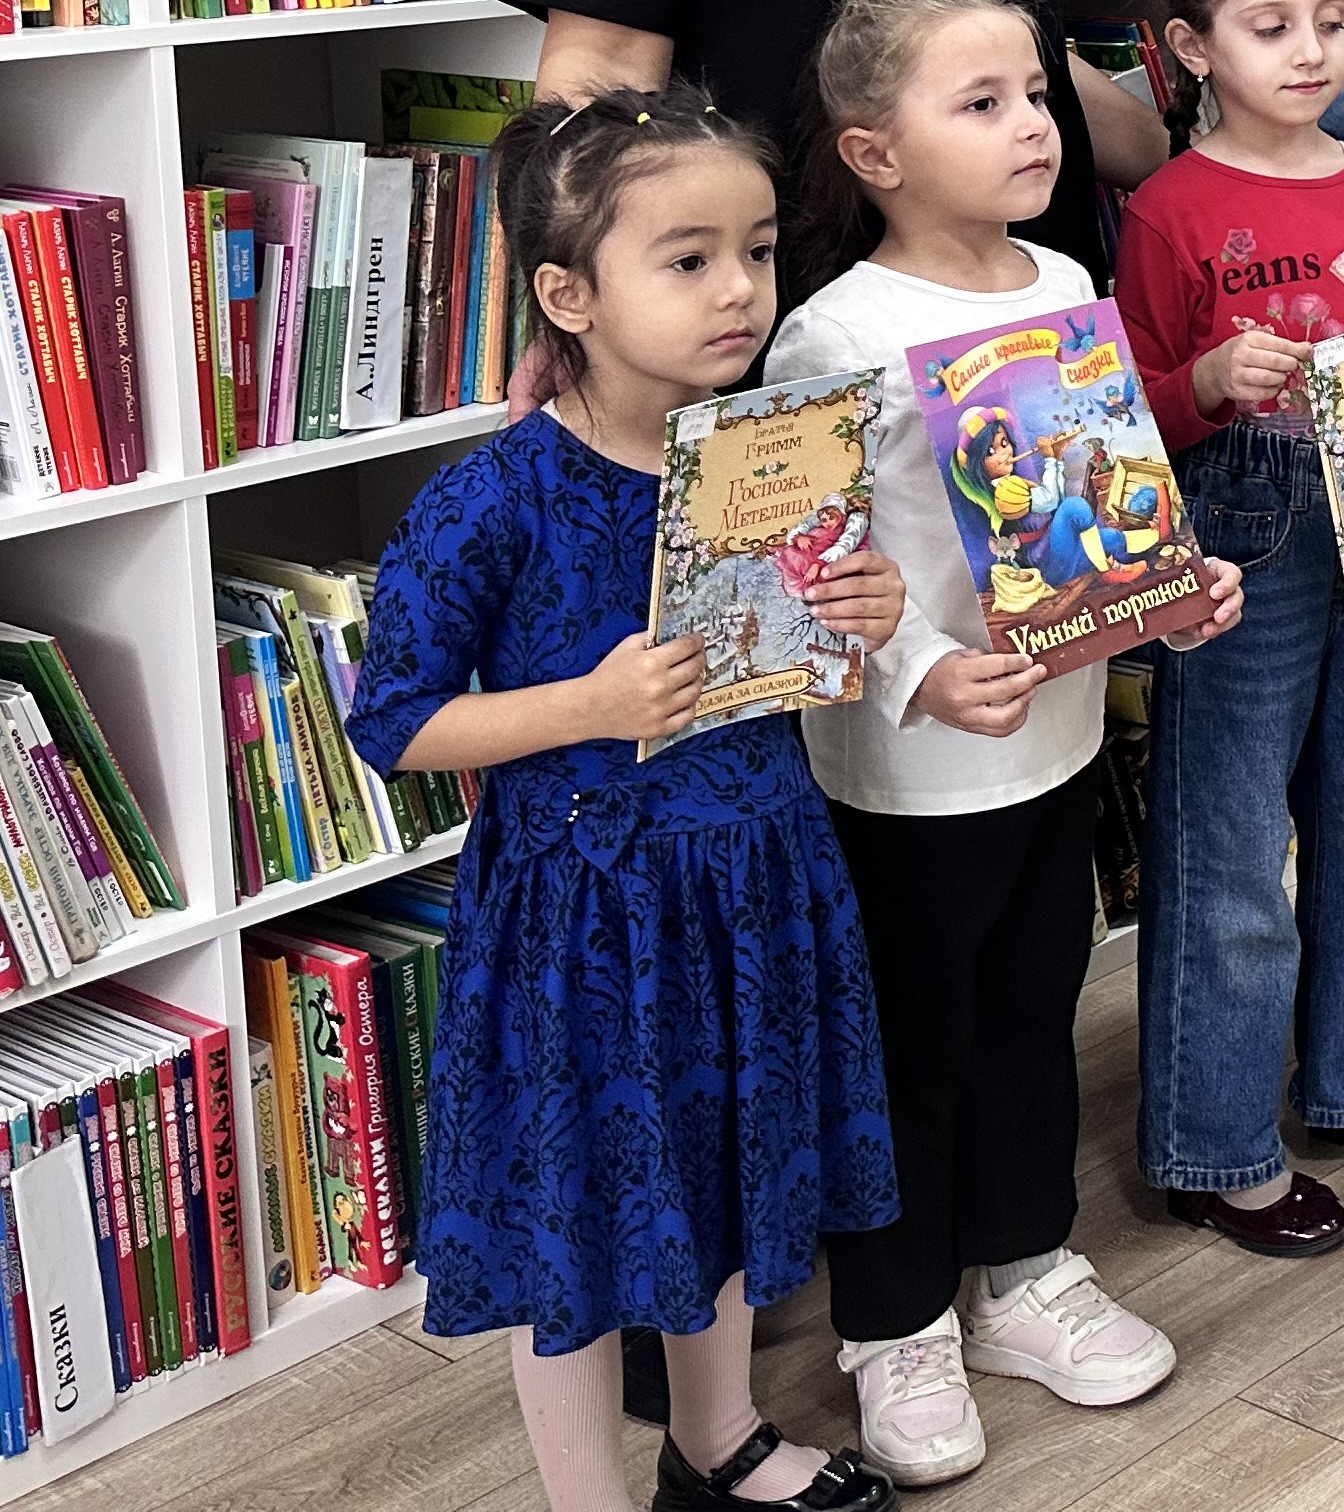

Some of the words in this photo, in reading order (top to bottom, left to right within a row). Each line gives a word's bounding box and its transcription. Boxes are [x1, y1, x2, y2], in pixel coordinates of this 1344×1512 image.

[110, 247, 125, 288] Лагин
[191, 259, 203, 302] СТАРИК
[1200, 251, 1322, 297] Jeans
[27, 279, 44, 323] СТАРИК
[60, 275, 77, 319] СТАРИК
[112, 295, 130, 348] Старик
[353, 234, 389, 401] А.Линдгрен
[10, 321, 29, 376] СТАРИК
[34, 323, 55, 384] ХОТТАБЫЧ
[67, 319, 87, 380] ХОТТАБЫЧ
[194, 304, 207, 362] ХОТТАБЫЧ
[118, 352, 137, 424] Хоттабыч
[949, 353, 992, 392] Самые
[994, 334, 1054, 366] красивые
[1066, 352, 1115, 384] сказки
[744, 433, 803, 459] ГРИММ
[753, 421, 795, 439] БРАТЬЯ
[718, 495, 815, 537] МЕТЕЛИЦА
[726, 472, 810, 507] ГОСПОЖА
[1006, 606, 1096, 657] Умный
[1102, 568, 1200, 633] портной
[311, 696, 331, 733] СКАЗКИ
[735, 682, 751, 701] ЗА
[752, 671, 803, 699] СКАЗКОЙ
[9, 726, 30, 762] СЛОВО
[288, 692, 324, 809] ПЕТЬКА-МИКРОБ
[10, 768, 39, 821] ЗАРЯДКА
[24, 761, 56, 822] ВОЛШЕБНОЕ
[32, 824, 54, 863] ОСТЕР
[48, 864, 79, 925] ГРИГОРИЙ
[353, 975, 376, 1046] Остера
[400, 961, 419, 1025] СКАЗКИ
[405, 1024, 426, 1098] РУССКИЕ
[205, 1045, 234, 1180] СКАЗКИ
[361, 1051, 388, 1133] Григория
[255, 1083, 278, 1164] СКАЗКИ
[368, 1134, 393, 1221] СКАЗКИ
[262, 1162, 286, 1253] ЛЮБИМЫЕ
[215, 1184, 246, 1333] РУССКИЕ
[312, 1218, 327, 1263] САМЫЕ
[379, 1222, 399, 1265] ВСЕ
[44, 1301, 80, 1413] Сказки
